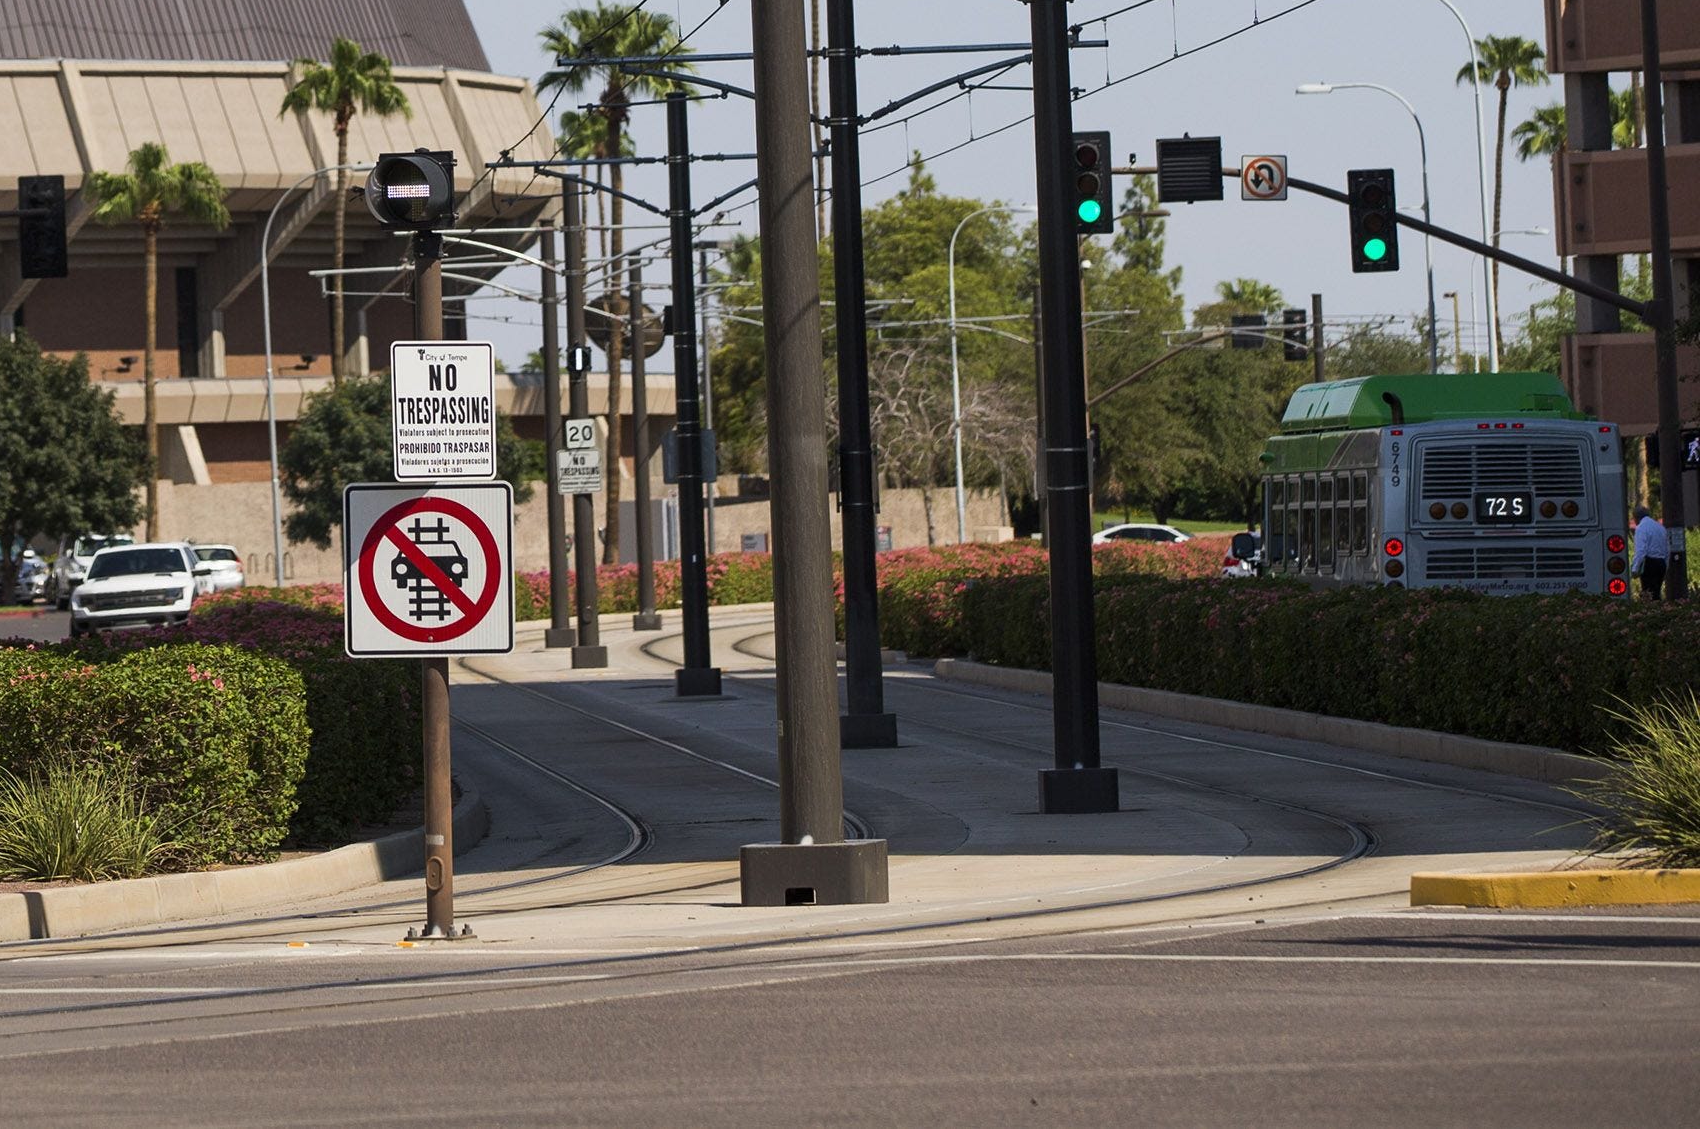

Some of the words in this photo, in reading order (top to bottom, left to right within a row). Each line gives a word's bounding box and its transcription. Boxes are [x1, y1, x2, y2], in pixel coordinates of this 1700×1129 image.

[425, 354, 438, 362] City
[448, 354, 468, 362] Tempe
[428, 364, 457, 391] NO
[398, 397, 489, 424] TRESPASSING
[399, 428, 425, 437] Violators
[426, 428, 447, 438] subject
[448, 428, 455, 436] to
[456, 428, 490, 437] prosecution
[569, 425, 593, 442] 20
[399, 442, 441, 454] PROHIBIDO
[443, 441, 490, 453] TRASPASAR
[401, 458, 429, 466] Violadores
[573, 456, 586, 465] NO
[1391, 442, 1400, 487] 6749
[1485, 497, 1508, 516] 72
[1512, 497, 1524, 516] S
